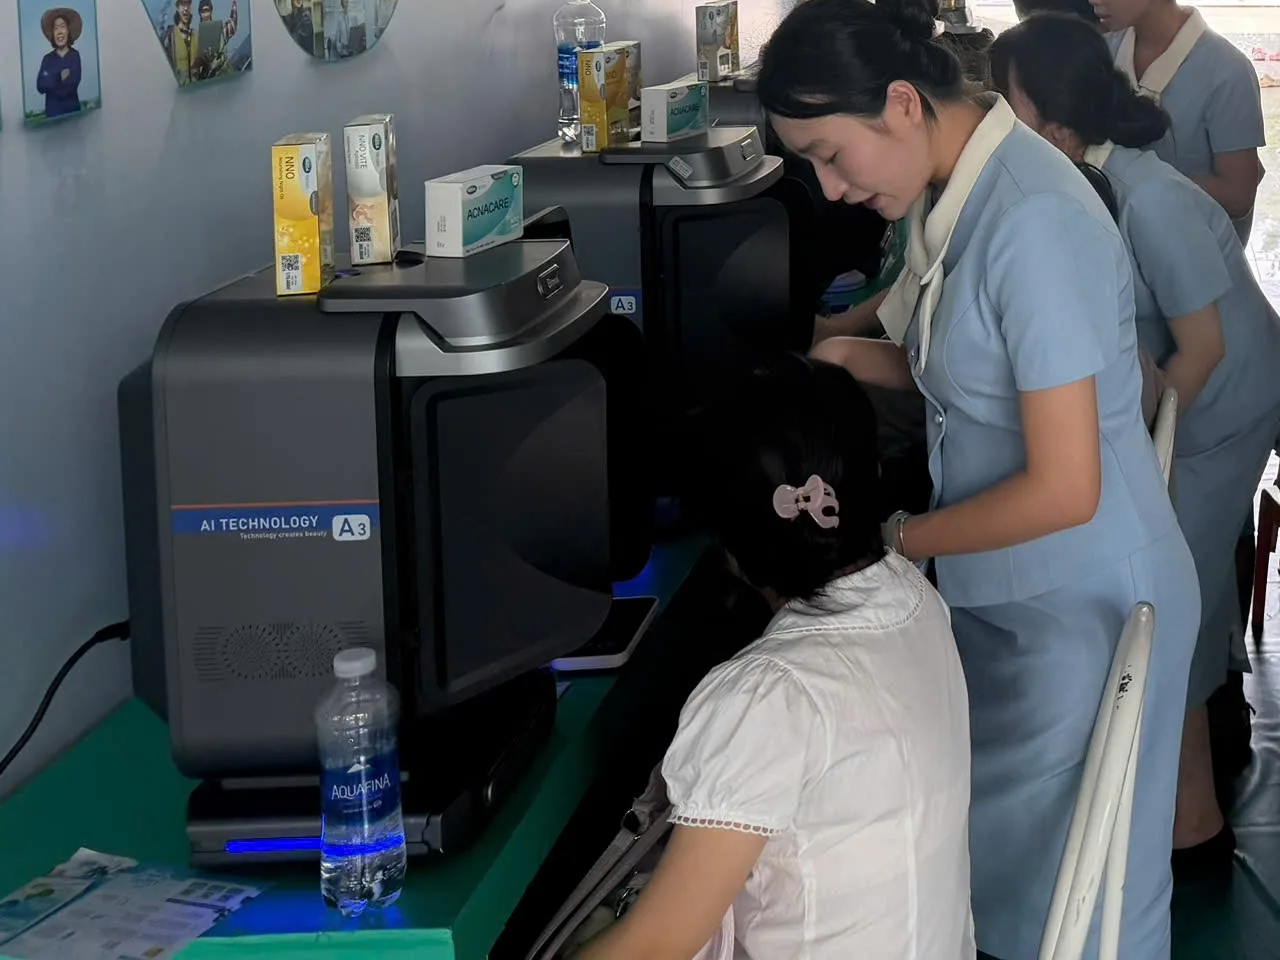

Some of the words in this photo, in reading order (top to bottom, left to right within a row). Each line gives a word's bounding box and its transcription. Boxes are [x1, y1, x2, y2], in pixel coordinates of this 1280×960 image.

[669, 102, 700, 117] ACNACARE
[286, 156, 295, 180] NNO
[467, 197, 510, 221] ACNACARE
[615, 297, 633, 311] A3
[200, 519, 215, 532] AI
[219, 515, 319, 531] TECHNOLOGY
[338, 517, 367, 537] A3
[240, 531, 277, 540] Technology
[278, 530, 304, 539] creates
[306, 529, 328, 539] beauty
[331, 772, 391, 800] AQUAFINA
